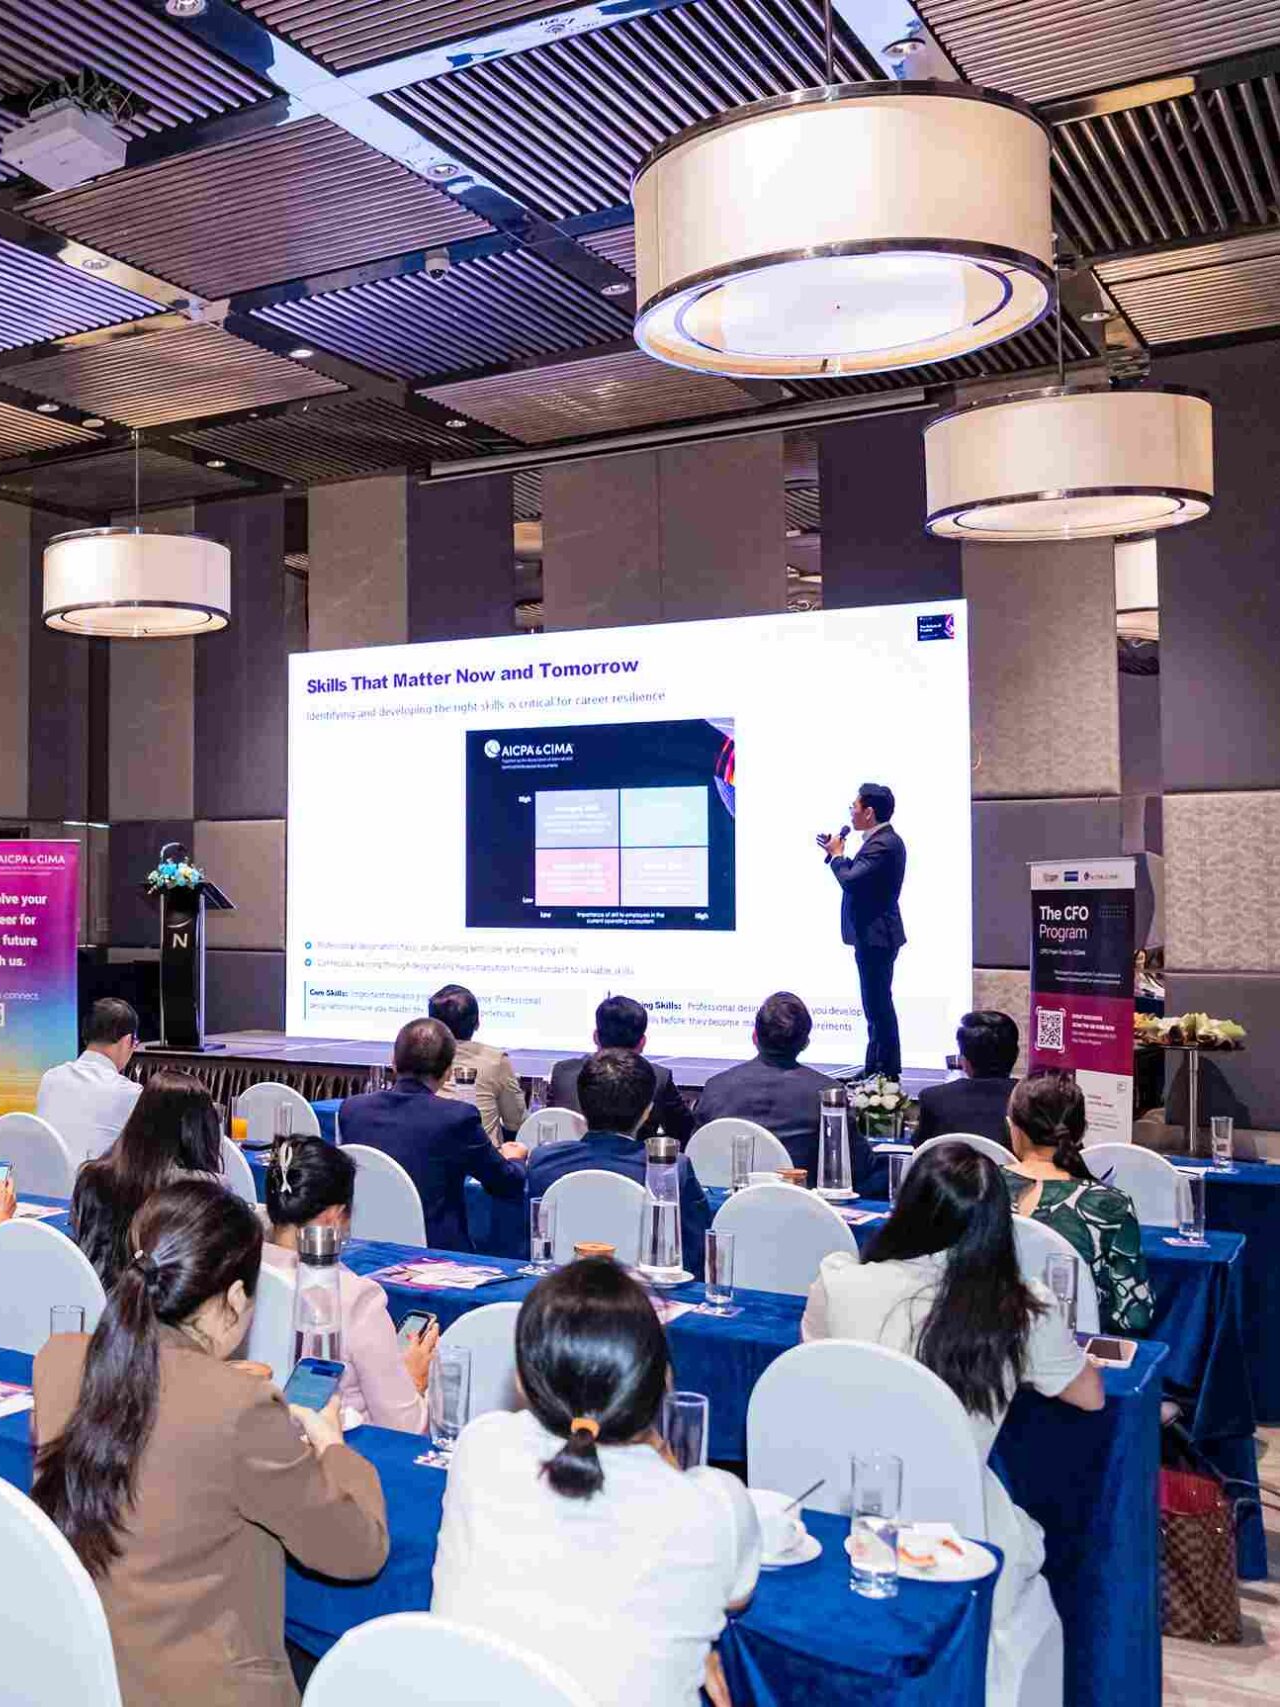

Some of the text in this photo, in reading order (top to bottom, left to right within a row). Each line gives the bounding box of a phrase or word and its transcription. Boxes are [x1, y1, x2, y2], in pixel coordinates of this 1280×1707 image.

[307, 659, 639, 694] Skills That Matter Now and Tomorrow
[306, 690, 666, 722] Identifying and developing the right skills is critical for career resilience
[501, 743, 574, 757] AICPA & CIMA
[29, 856, 36, 864] &
[36, 854, 65, 864] CIMA
[21, 894, 48, 907] your
[19, 913, 37, 925] for
[1039, 905, 1089, 921] The CFO
[1039, 923, 1088, 942] Program
[2, 934, 39, 946] future
[172, 932, 188, 949] N
[8, 957, 26, 967] us.
[309, 988, 325, 997] Core
[654, 1000, 682, 1011] Skills:
[687, 1001, 736, 1012] Professional
[811, 1006, 863, 1017] you develop
